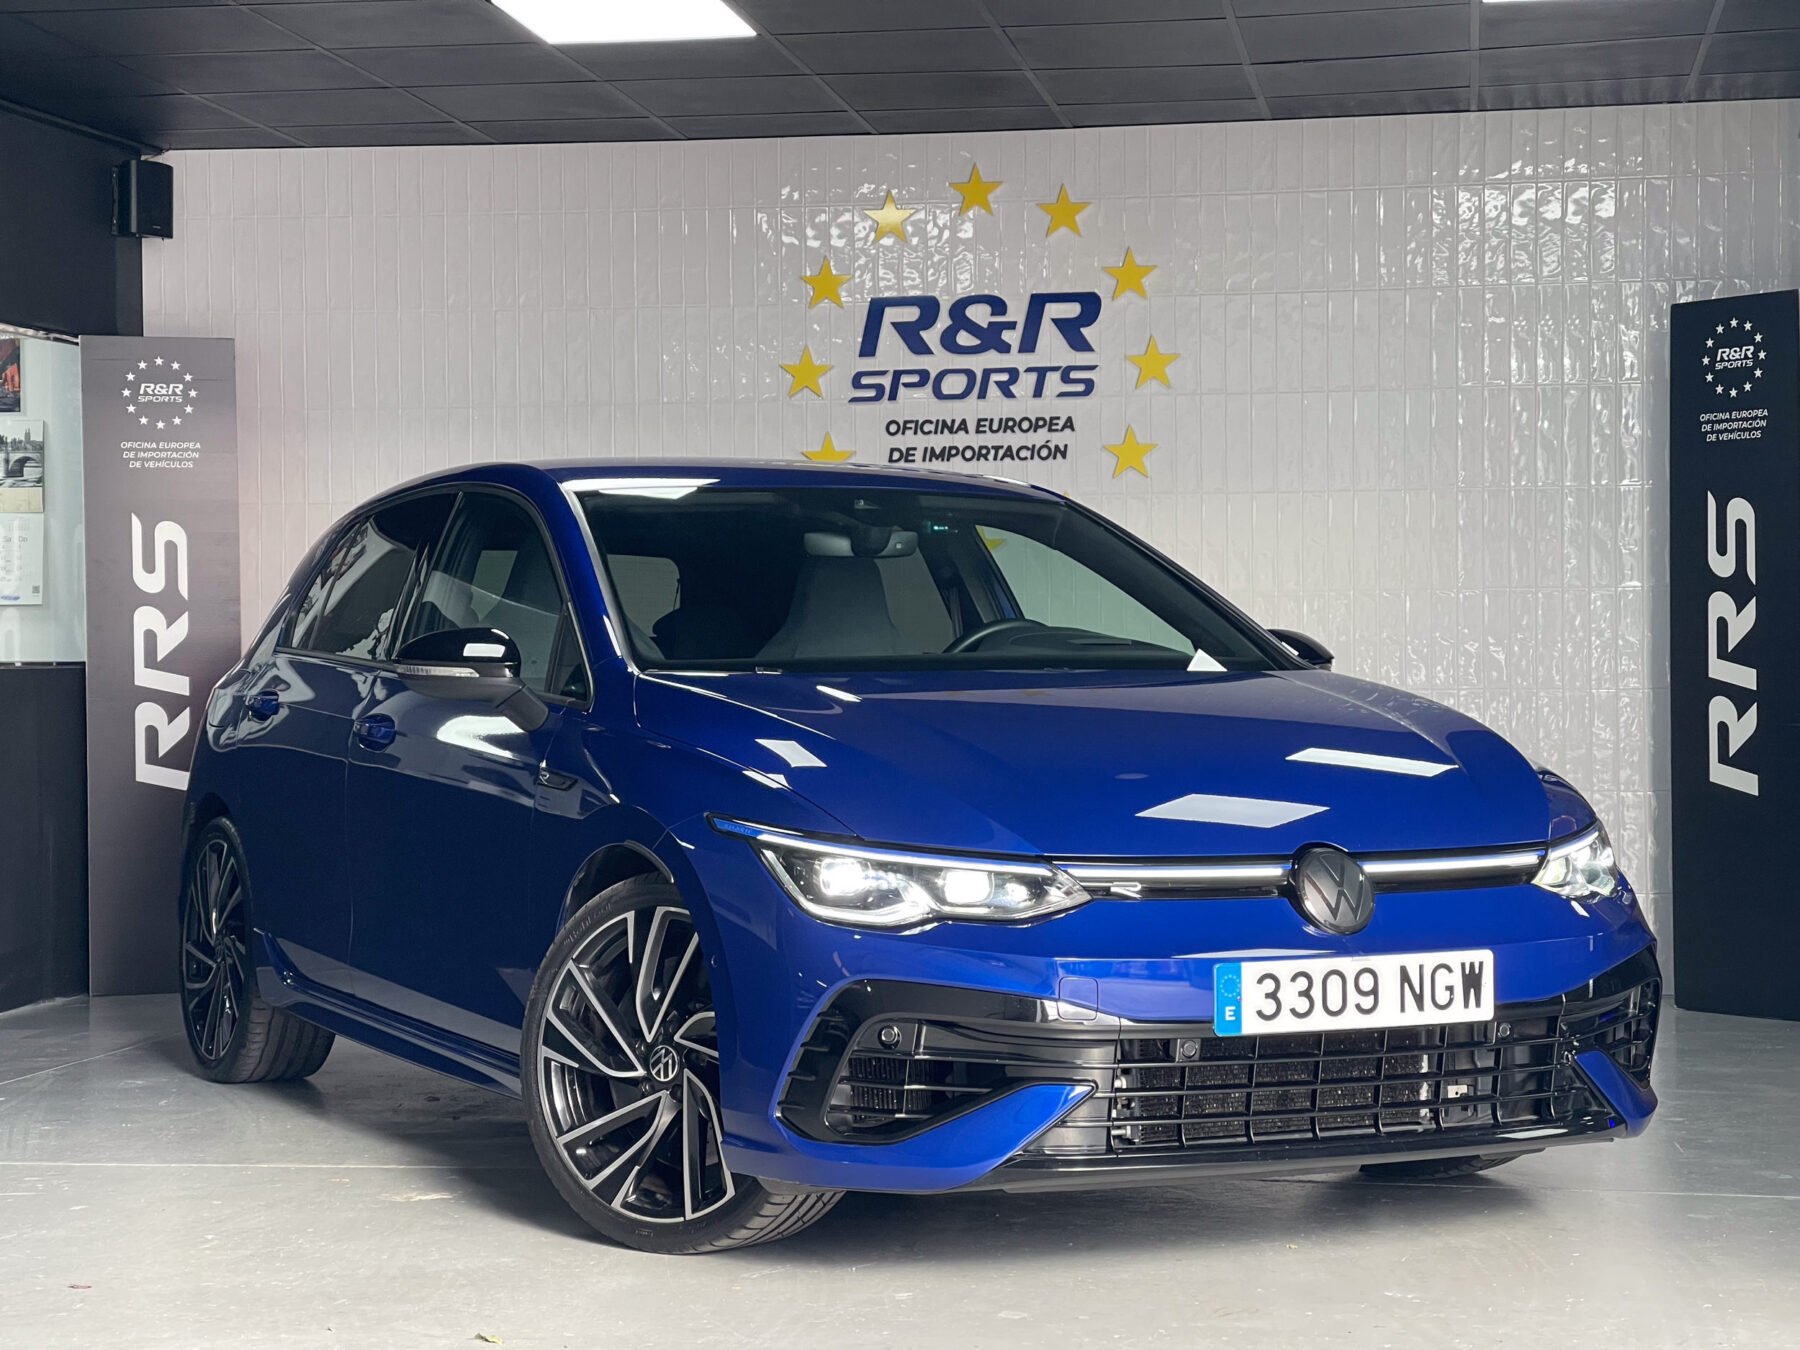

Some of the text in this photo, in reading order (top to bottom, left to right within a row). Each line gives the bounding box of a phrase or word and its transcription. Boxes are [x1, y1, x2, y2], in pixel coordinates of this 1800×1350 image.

[858, 291, 1102, 358] R&R
[1716, 345, 1754, 361] R&R
[1715, 359, 1753, 370] SPORTS
[139, 383, 184, 395] R&R
[848, 364, 1099, 403] SPORTS
[137, 395, 183, 403] SPORTS
[1699, 409, 1768, 421] OFICINA EUROPEA
[885, 415, 1076, 436] OFICINA EUROPEA
[1701, 418, 1767, 432] DE IMPORTACIÓN
[1706, 430, 1762, 442] DE VEHÍCULOS
[120, 441, 201, 450] OFICINA EUROPEA
[888, 440, 1069, 463] DE IMPORTACIÓN
[122, 450, 200, 459] DE IMPORTACIÓN
[129, 459, 193, 468] DE VEHÍCULOS
[1707, 490, 1759, 796] RRS
[131, 512, 190, 791] RRS
[1255, 960, 1485, 1022] 3309 NGW
[1225, 1006, 1236, 1021] E
